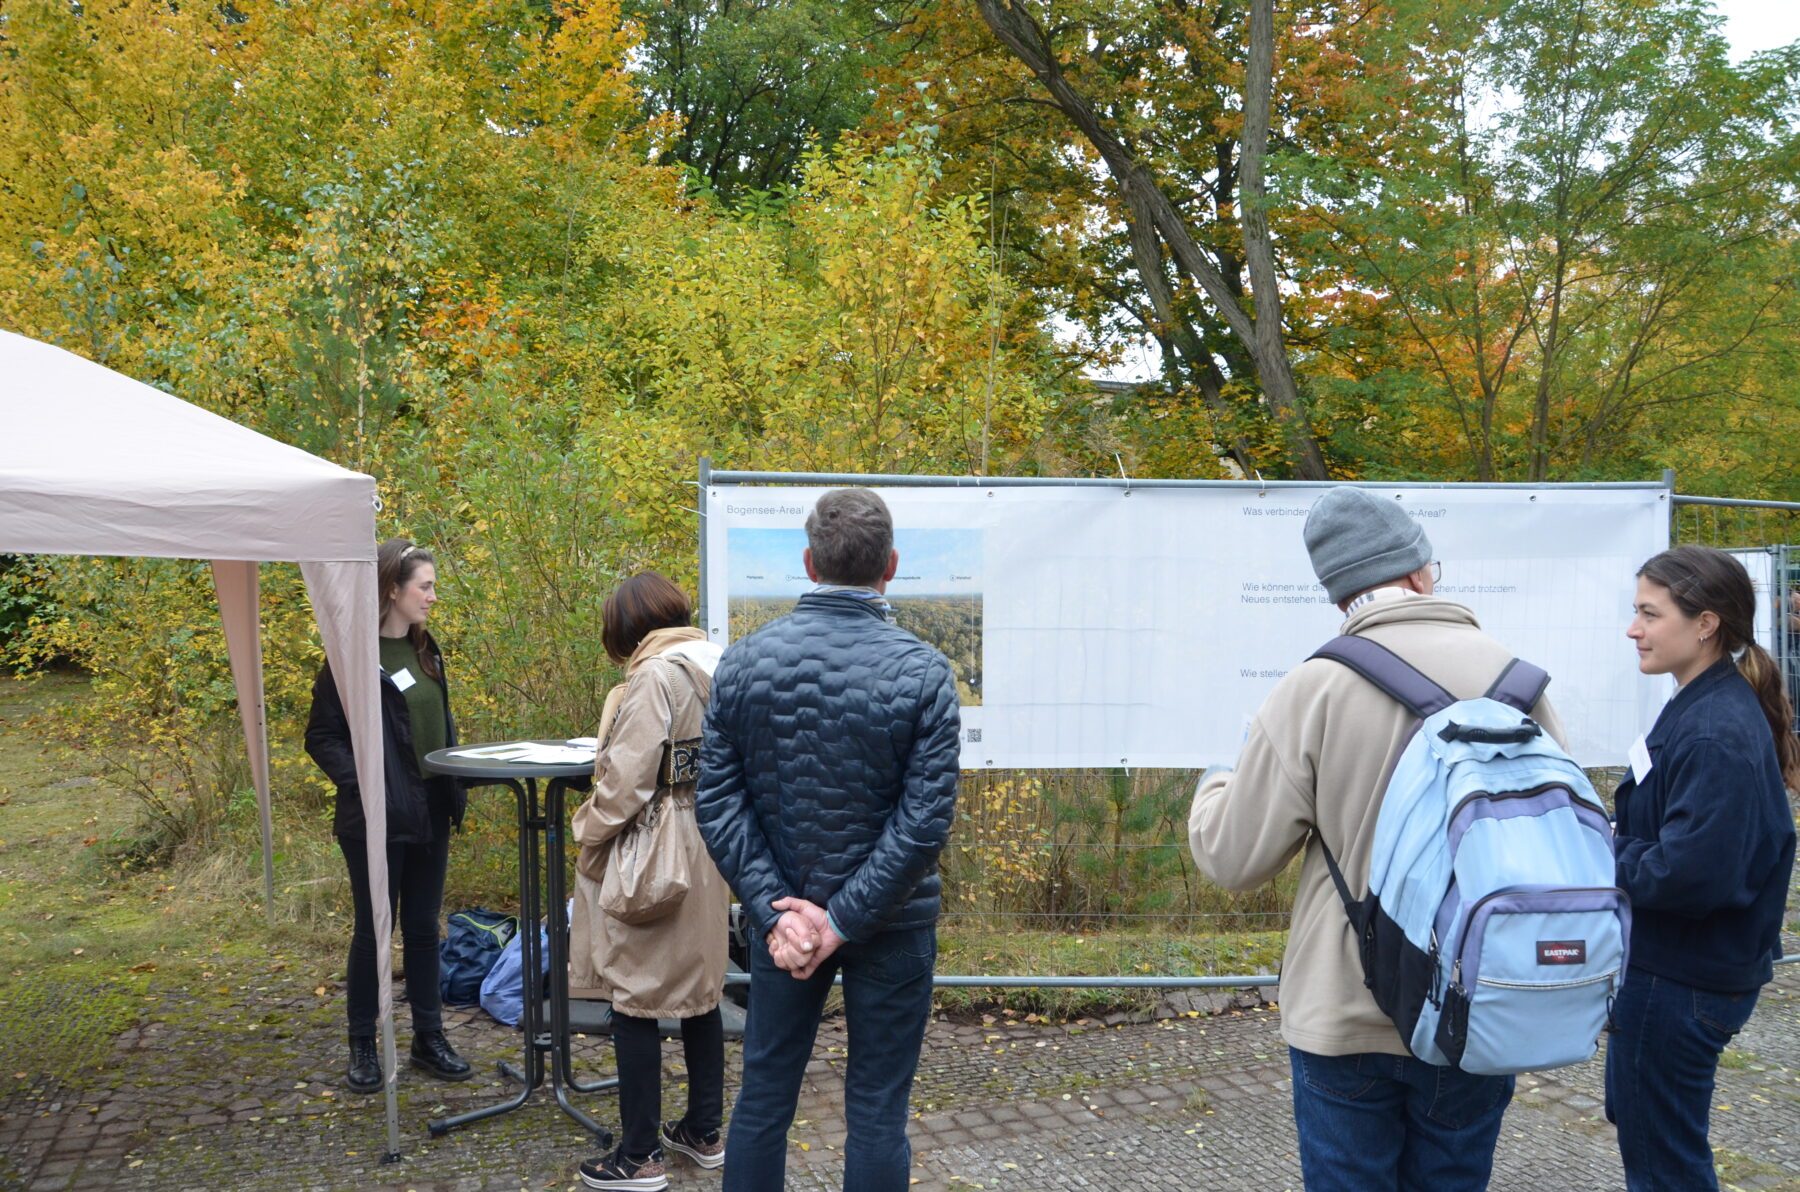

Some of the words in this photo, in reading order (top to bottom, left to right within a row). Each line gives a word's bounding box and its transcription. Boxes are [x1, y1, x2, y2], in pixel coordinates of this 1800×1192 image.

[726, 504, 804, 516] Bogensee-Areal
[1243, 506, 1263, 516] Was
[1265, 507, 1310, 517] verbinden
[1408, 508, 1447, 518] e-Areal?
[1242, 582, 1260, 592] Wie
[1261, 582, 1295, 592] können
[1297, 582, 1310, 592] wir
[1433, 584, 1456, 593] chen
[1458, 584, 1476, 593] und
[1477, 584, 1517, 593] trotzdem
[1241, 594, 1271, 604] Neues
[1272, 595, 1317, 604] entstehen
[1318, 596, 1332, 604] las
[1240, 668, 1258, 678] Wie
[1544, 949, 1579, 957] EASTPAK
